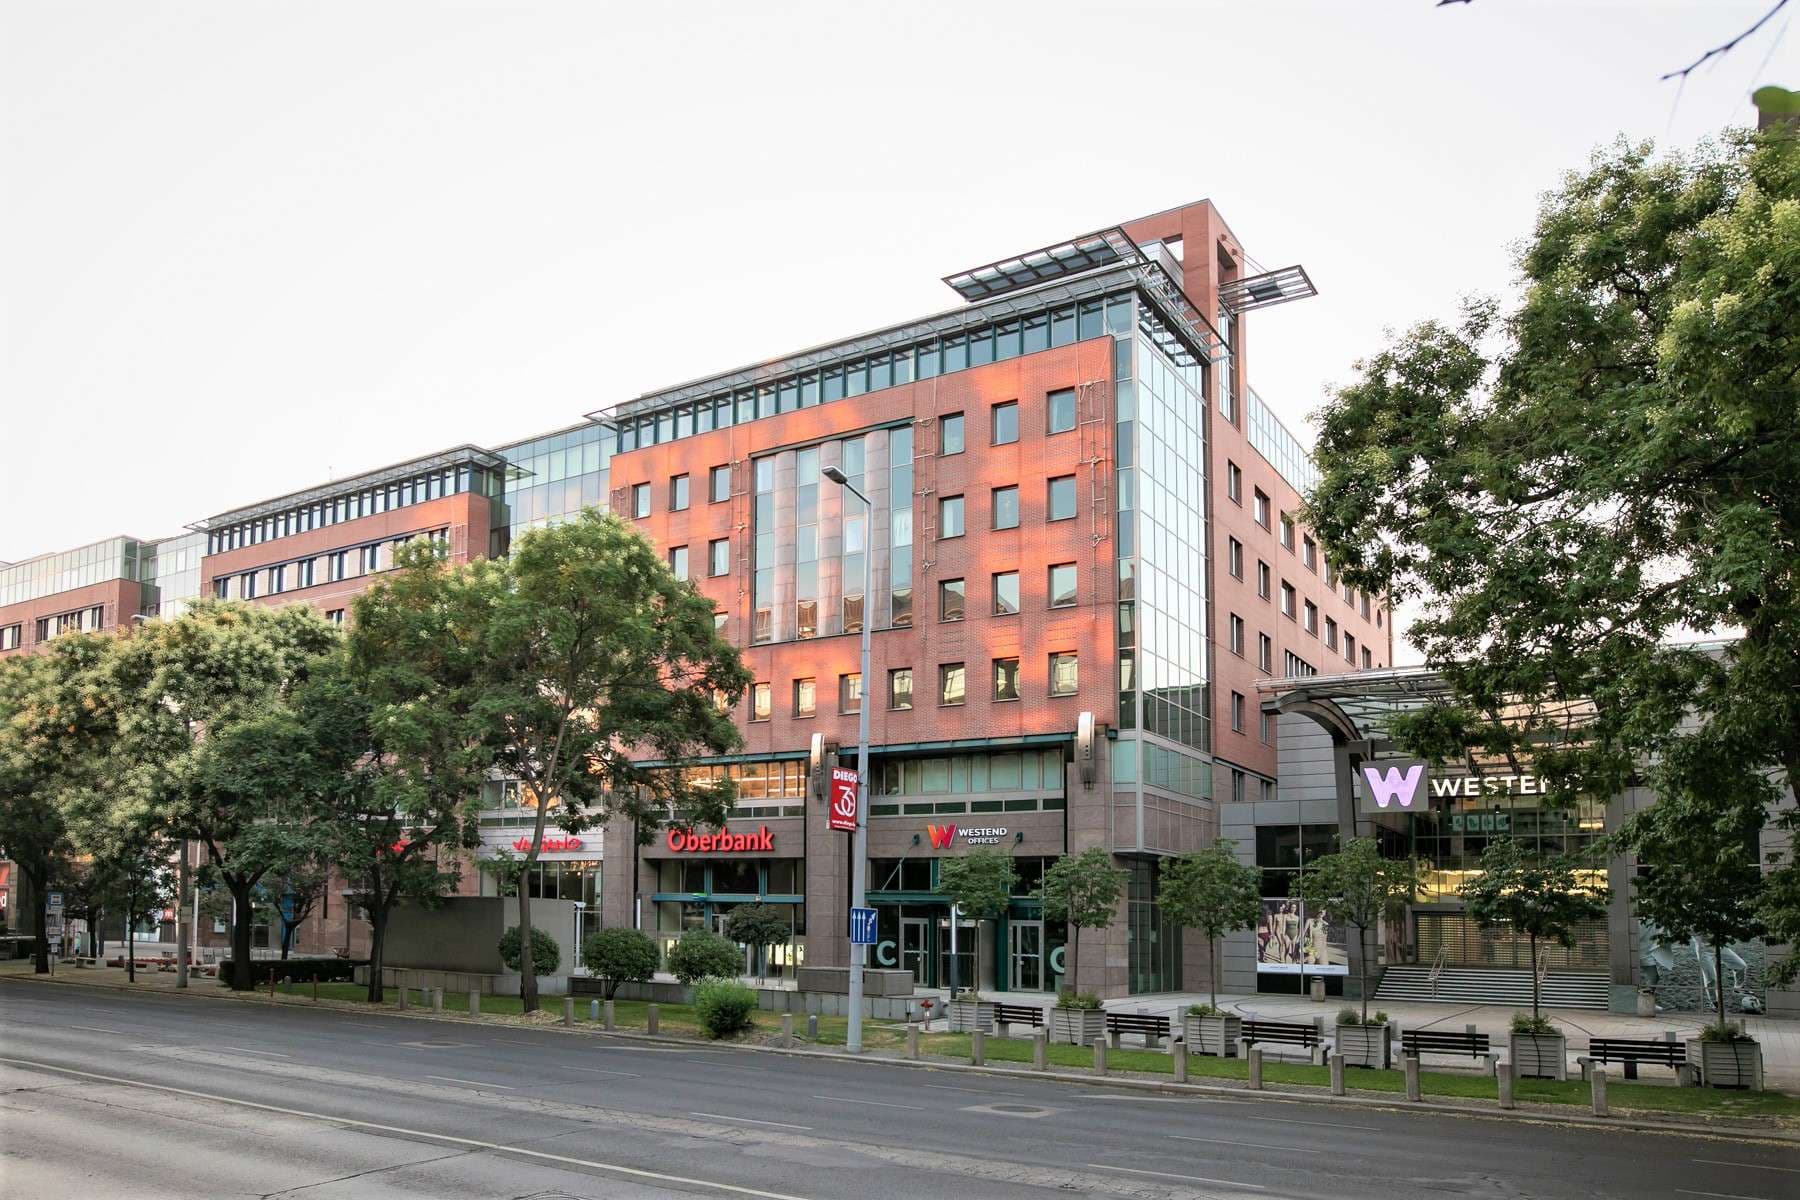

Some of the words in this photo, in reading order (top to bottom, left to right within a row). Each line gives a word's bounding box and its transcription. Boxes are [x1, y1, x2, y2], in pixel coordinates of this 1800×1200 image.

[833, 769, 857, 783] DIEGO
[1363, 765, 1424, 808] W
[1432, 775, 1584, 797] WESTE
[667, 824, 774, 852] Oberbank
[928, 824, 957, 849] W
[958, 827, 1008, 836] WESTEND
[876, 940, 897, 966] C
